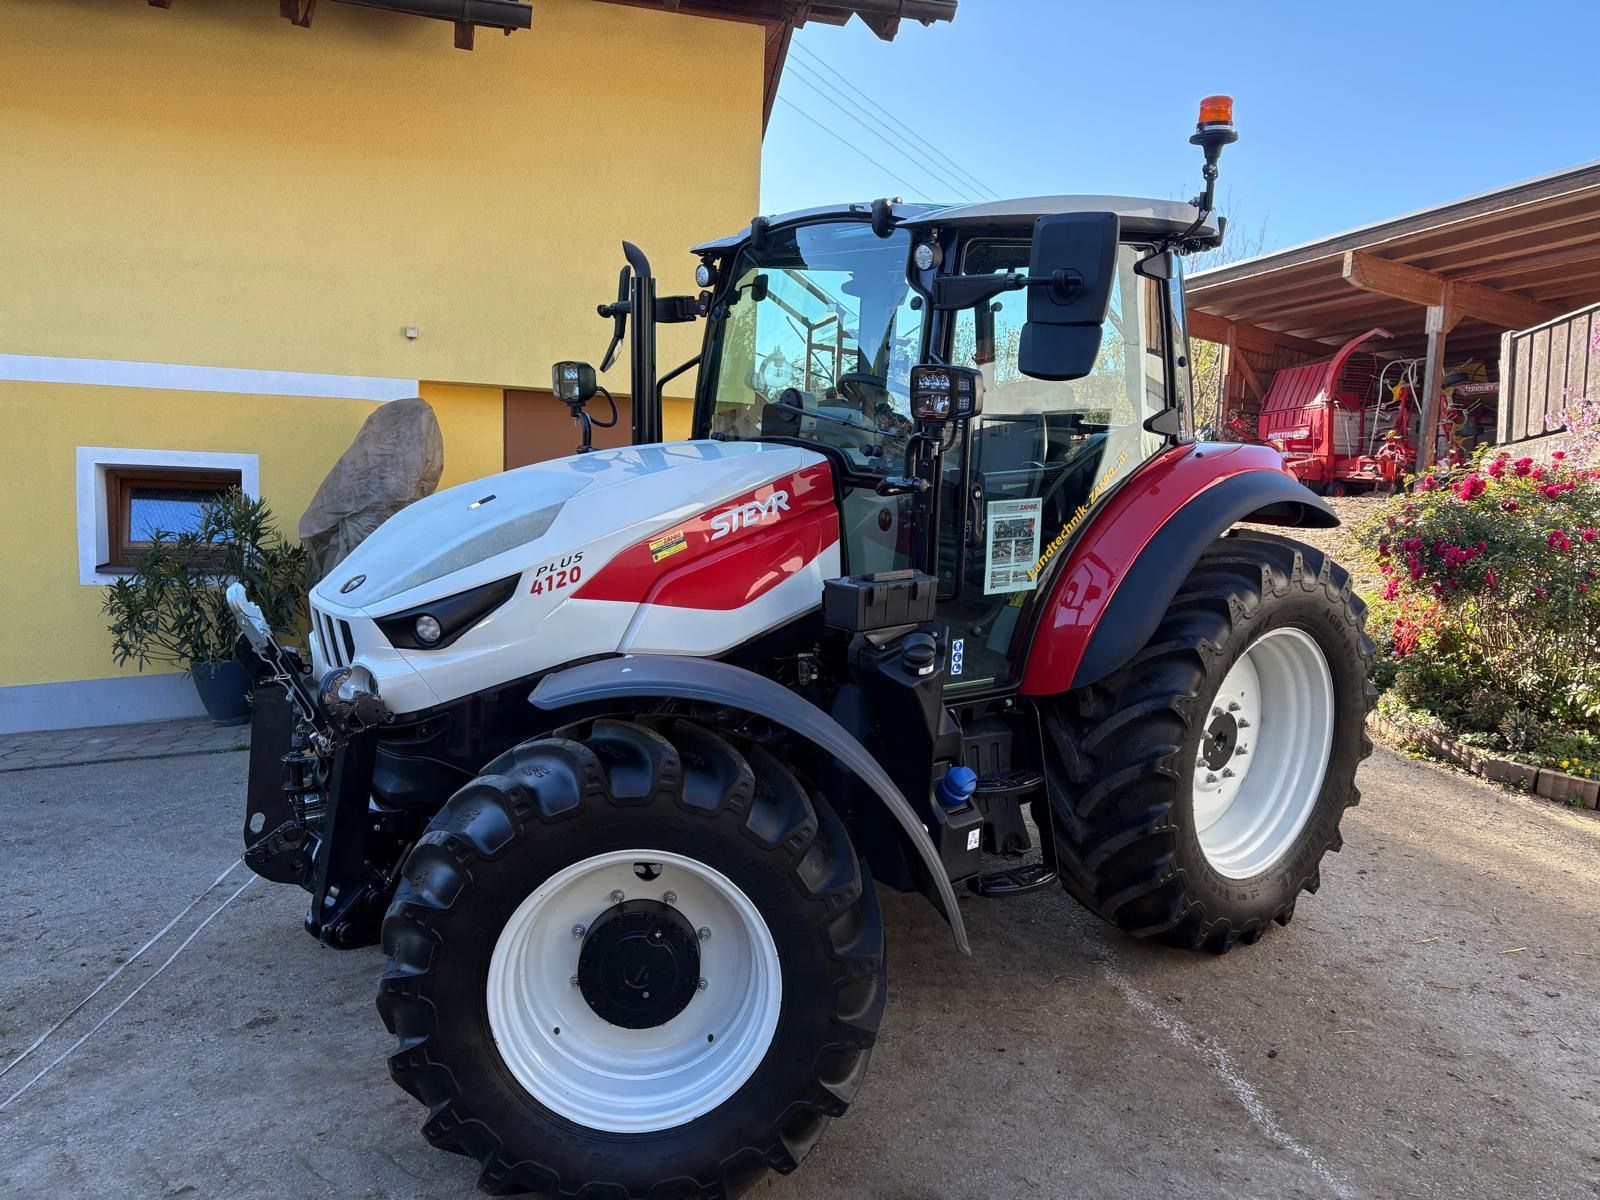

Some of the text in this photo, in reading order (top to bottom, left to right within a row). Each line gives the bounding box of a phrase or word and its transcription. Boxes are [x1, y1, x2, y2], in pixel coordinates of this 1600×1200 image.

[710, 489, 791, 541] STEYR
[536, 551, 584, 577] PLUS
[530, 565, 582, 595] 4120
